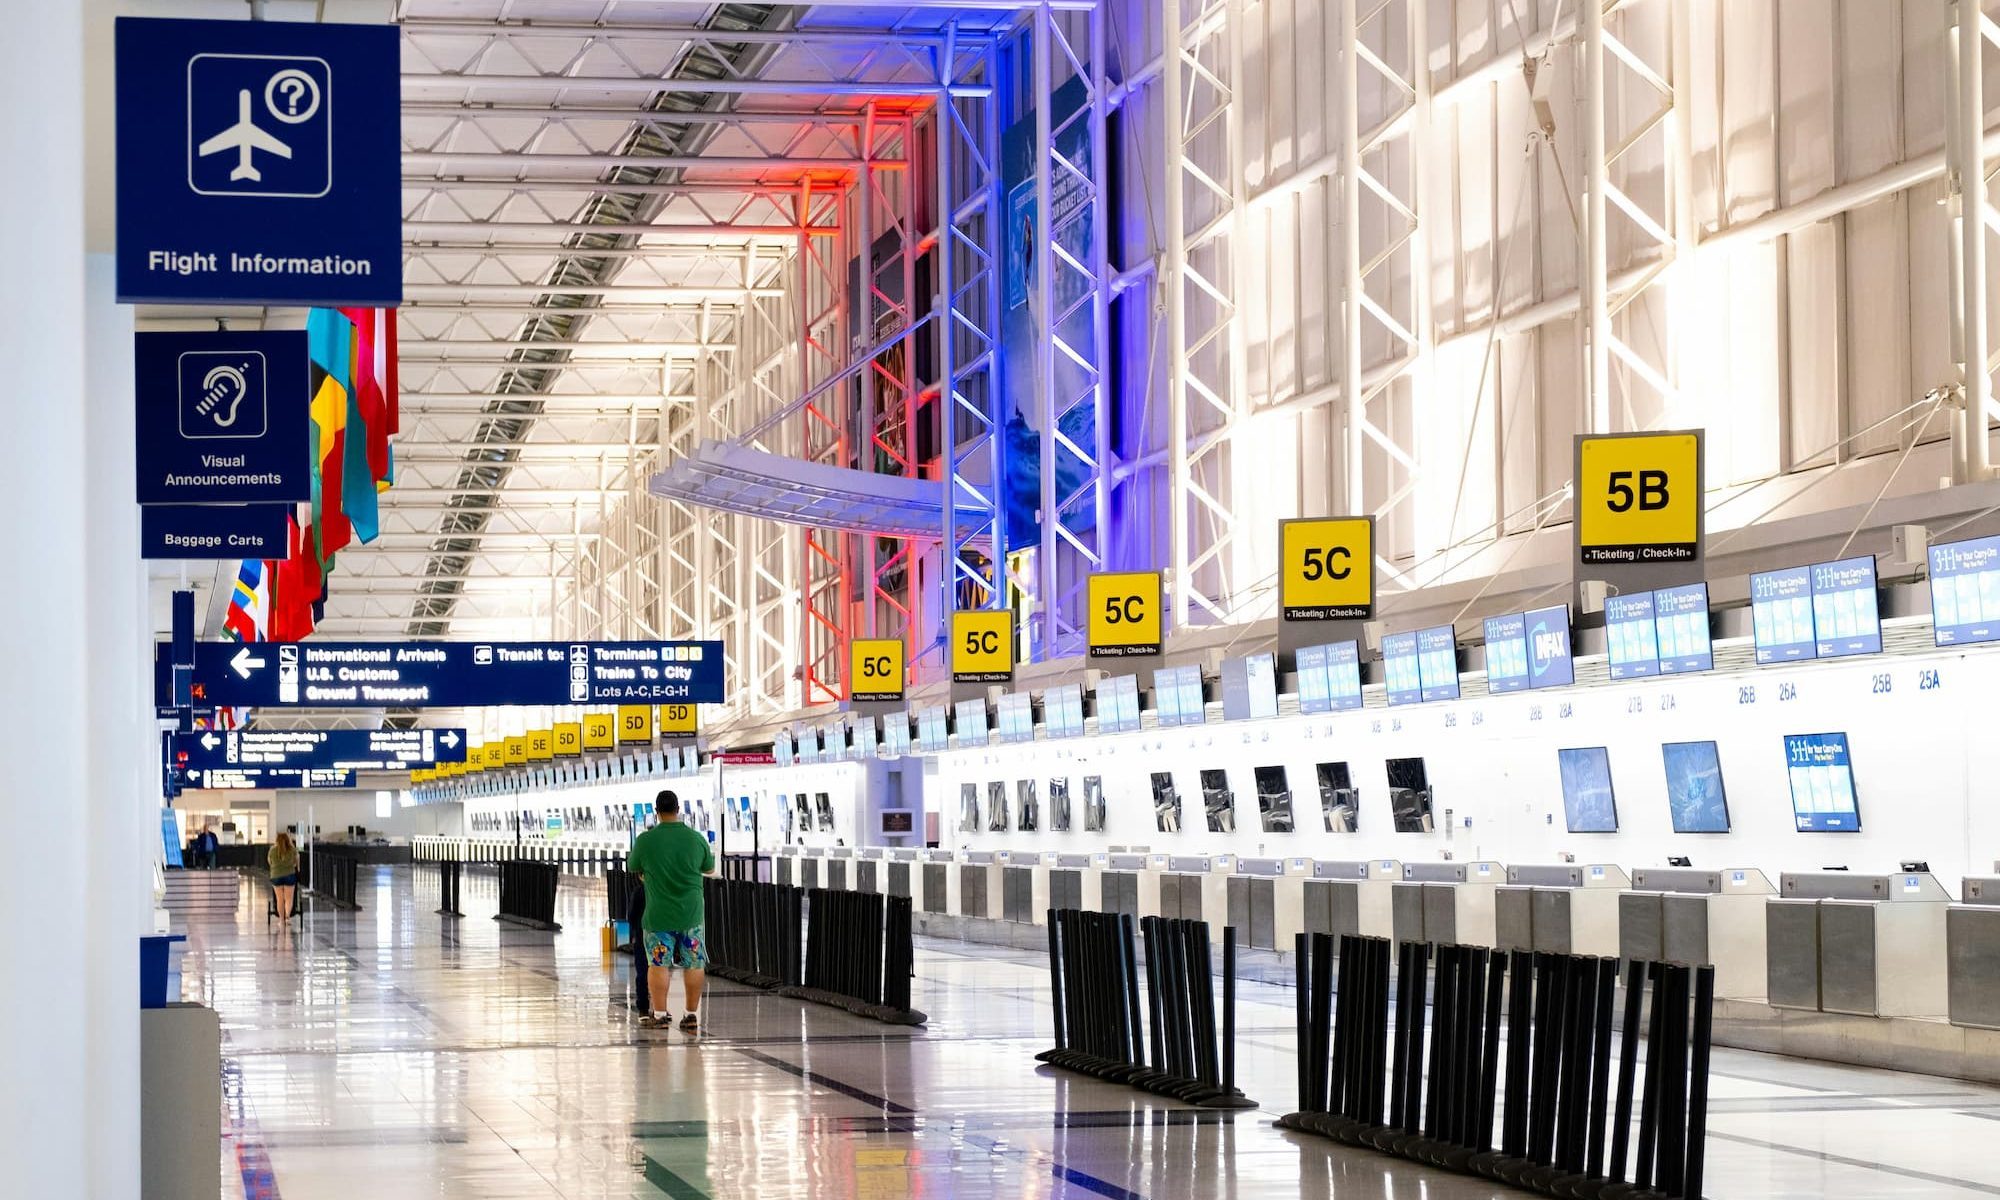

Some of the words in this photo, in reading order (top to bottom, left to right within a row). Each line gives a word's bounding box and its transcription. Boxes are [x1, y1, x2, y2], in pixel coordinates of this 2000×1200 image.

[149, 251, 217, 275] Flight
[231, 253, 371, 275] Information
[201, 454, 245, 467] Visual
[164, 473, 282, 486] Announcements
[1606, 470, 1670, 513] 5B
[165, 533, 222, 547] Baggage
[228, 534, 264, 547] Carts
[1591, 549, 1635, 561] Ticketing
[1643, 548, 1686, 559] Check-In
[1302, 546, 1351, 581] 5C
[1104, 595, 1144, 624] 5C
[1291, 609, 1324, 619] Ticketing
[1330, 608, 1363, 618] Check-In
[966, 631, 998, 655] 5C
[1535, 631, 1566, 660] INFAX
[306, 649, 390, 661] International
[396, 649, 447, 661] Arrivals
[497, 648, 543, 661] Transit
[547, 648, 565, 661] to:
[594, 647, 658, 661] Terminals
[1096, 647, 1123, 656] Ticketing
[306, 667, 333, 681] U.S.
[339, 667, 399, 681] Customs
[594, 665, 636, 679] Trains
[641, 665, 659, 679] To
[664, 665, 692, 681] City
[863, 656, 892, 677] 5C
[1872, 673, 1892, 693] 25B
[1919, 669, 1940, 690] 25A
[306, 686, 357, 699] Ground
[362, 686, 428, 701] Transport
[594, 686, 621, 697] Lots
[1739, 685, 1756, 704] 26B
[1779, 682, 1797, 701] 26A
[1661, 694, 1676, 711] 27A
[668, 705, 688, 721] 5D
[626, 716, 644, 730] 5D
[559, 732, 575, 745] 5D
[590, 725, 606, 737] 5D
[510, 745, 523, 755] 5E
[533, 739, 547, 750] 5E
[489, 750, 500, 760] 5E
